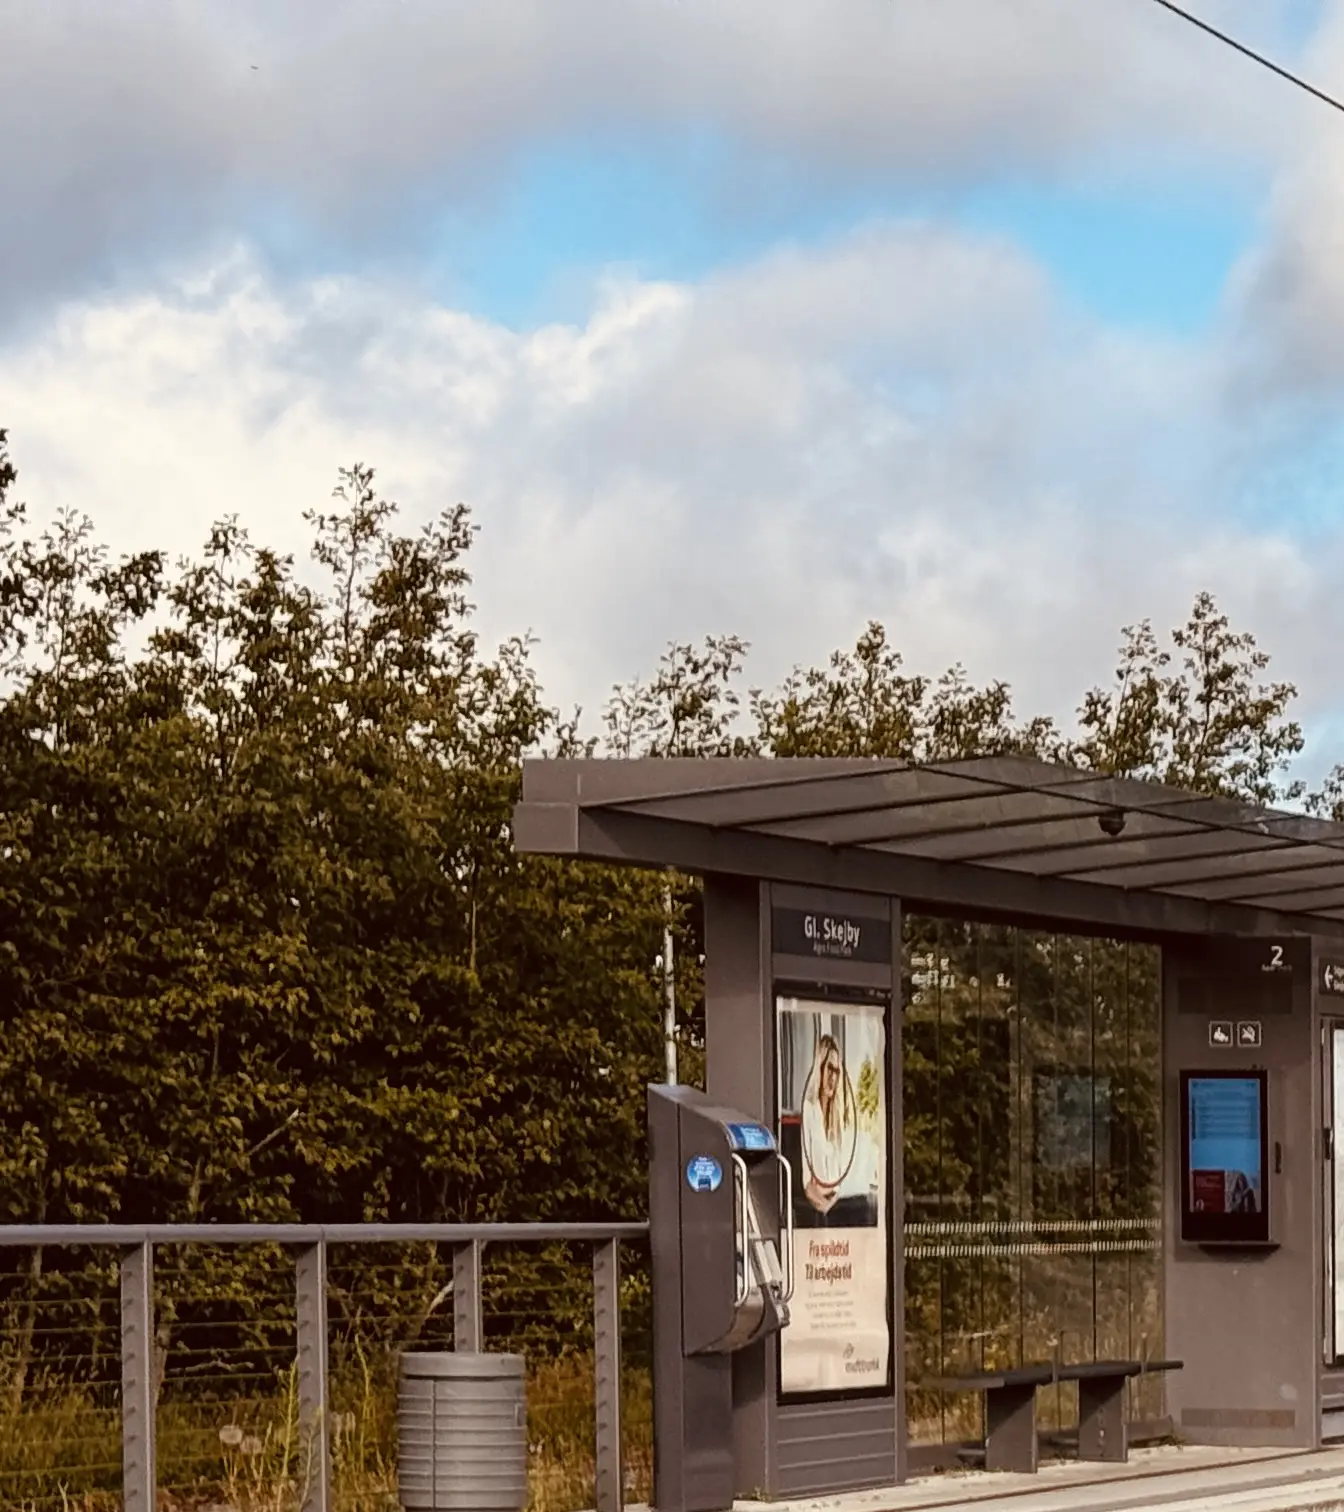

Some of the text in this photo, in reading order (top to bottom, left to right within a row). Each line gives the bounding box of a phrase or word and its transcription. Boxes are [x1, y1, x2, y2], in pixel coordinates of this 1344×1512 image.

[804, 915, 861, 948] Gl. Skejby
[1270, 945, 1283, 966] 2
